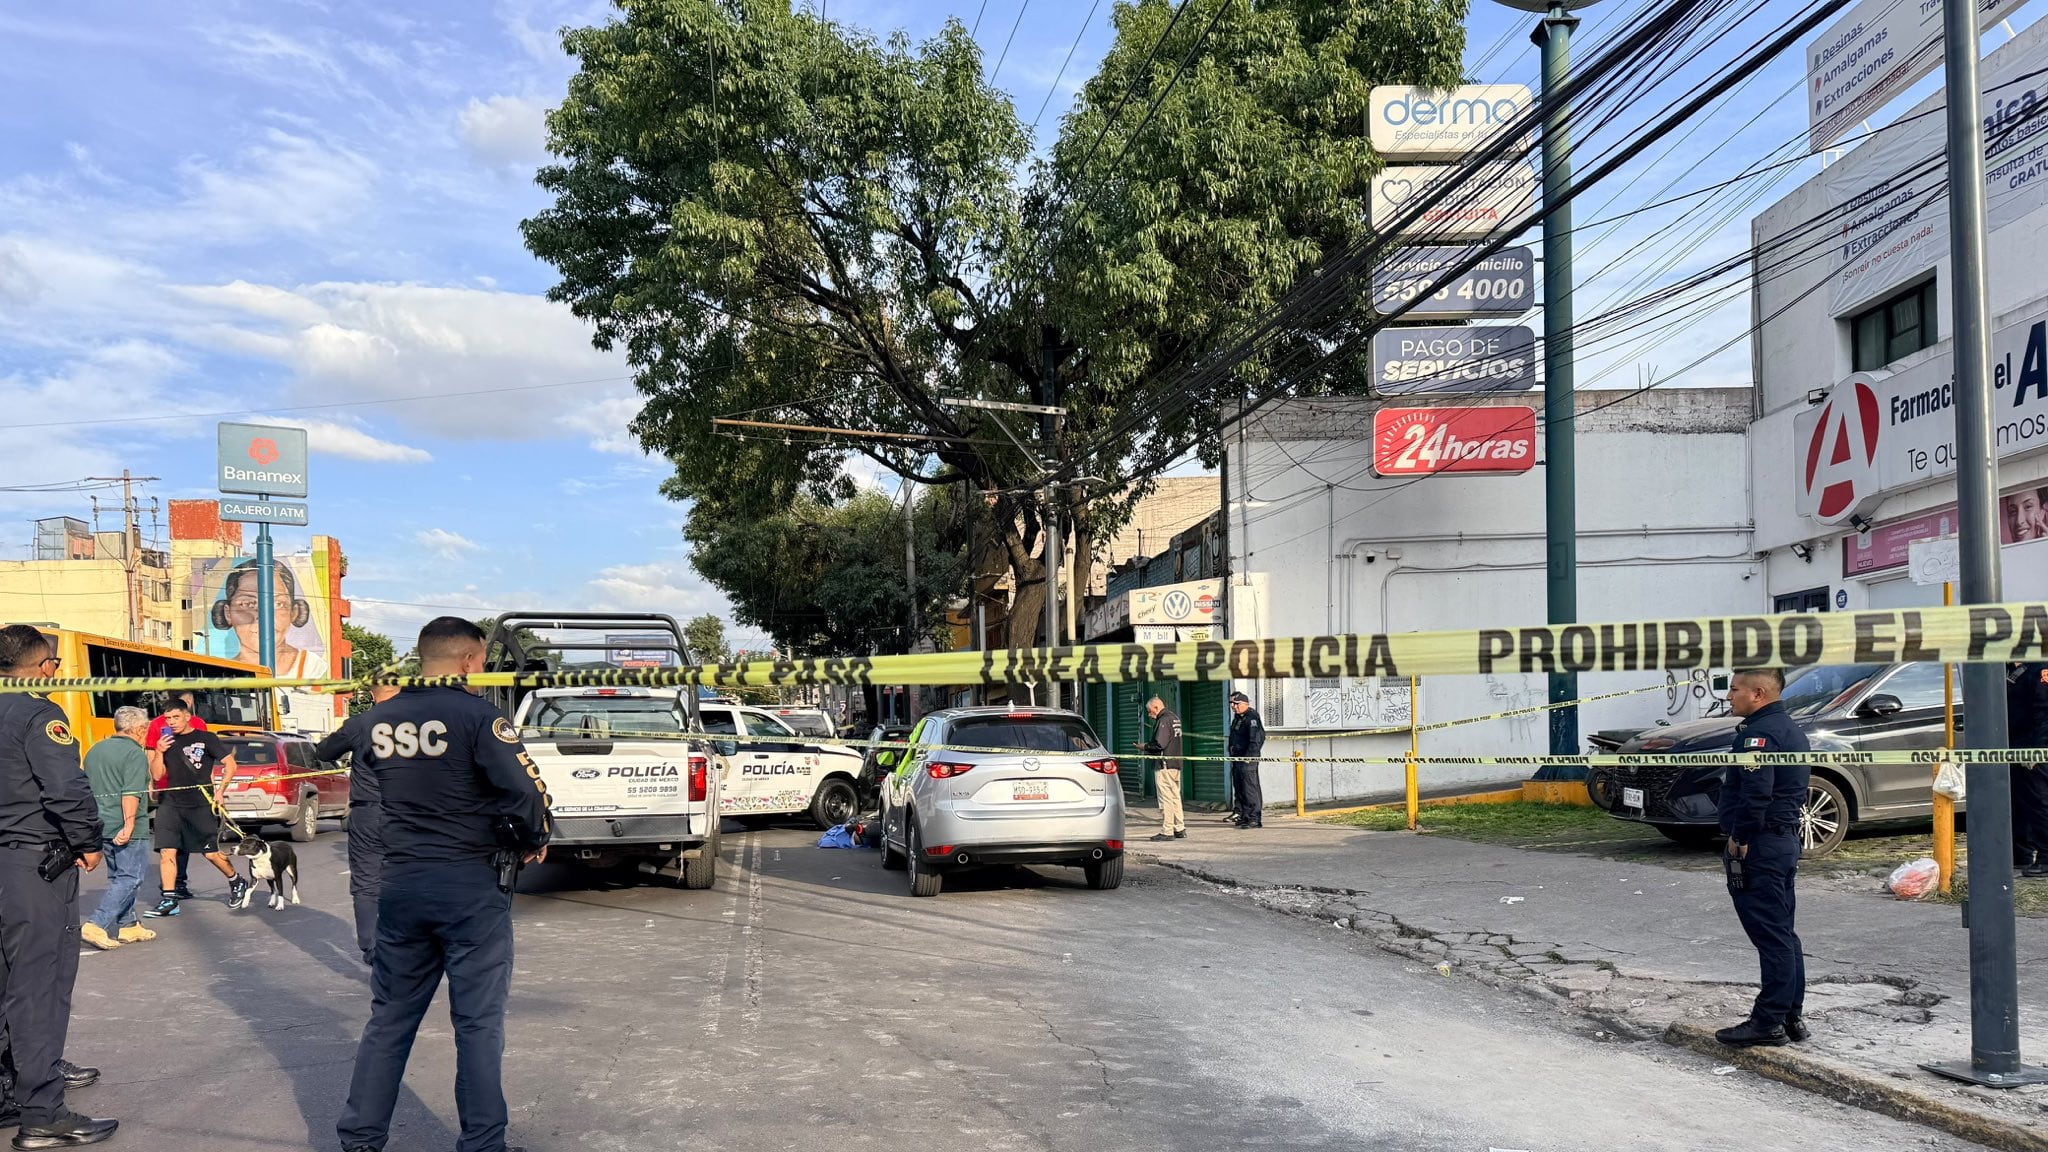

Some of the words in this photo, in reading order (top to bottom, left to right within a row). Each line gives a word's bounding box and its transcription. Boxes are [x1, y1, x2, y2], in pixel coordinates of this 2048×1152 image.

[1822, 21, 1865, 61] Resinas
[1822, 26, 1888, 86] Amalgamas
[1824, 46, 1894, 109] Extracciones
[1394, 130, 1459, 140] Especialistas
[1986, 153, 2025, 186] nsulta
[1851, 187, 1914, 233] Amalgamas
[1851, 210, 1920, 256] Extracciones
[1871, 252, 1882, 265] no
[1883, 240, 1909, 259] cuesta
[1910, 224, 1934, 244] nada!
[1457, 278, 1525, 300] 4000
[1401, 339, 1463, 356] PAGO
[1470, 338, 1500, 355] DE
[1382, 358, 1526, 381] SERVICIOS
[1890, 374, 1955, 427] Farmaci
[224, 466, 302, 484] Banamex
[1908, 447, 1928, 473] Te
[224, 503, 271, 516] CAJERO
[279, 507, 304, 518] ATM
[981, 646, 1100, 684] LINEA
[1120, 643, 1179, 682] DE
[1195, 634, 1399, 682] POLICIA
[1478, 616, 1824, 674] PROHIBIDO
[1854, 612, 1940, 663] EL
[371, 720, 449, 759] SSC
[607, 762, 679, 778] POLICÍA
[742, 761, 796, 775] POLICÍA
